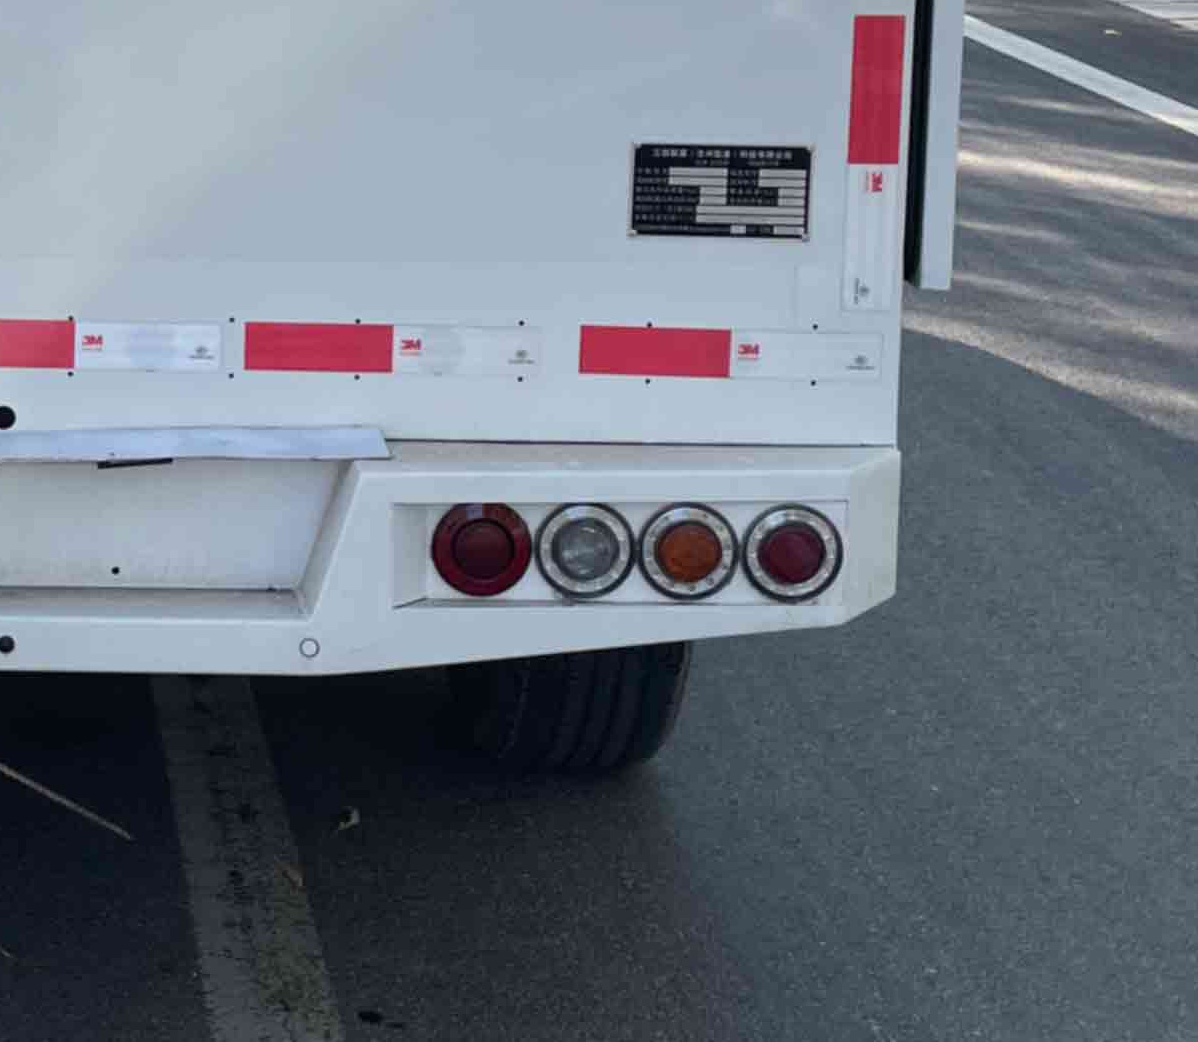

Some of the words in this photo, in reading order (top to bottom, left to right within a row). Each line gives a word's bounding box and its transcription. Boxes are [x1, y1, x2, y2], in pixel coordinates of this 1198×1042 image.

[871, 172, 883, 193] 3M
[82, 335, 104, 346] 3M
[400, 339, 422, 350] 3M
[737, 343, 760, 355] 3M
